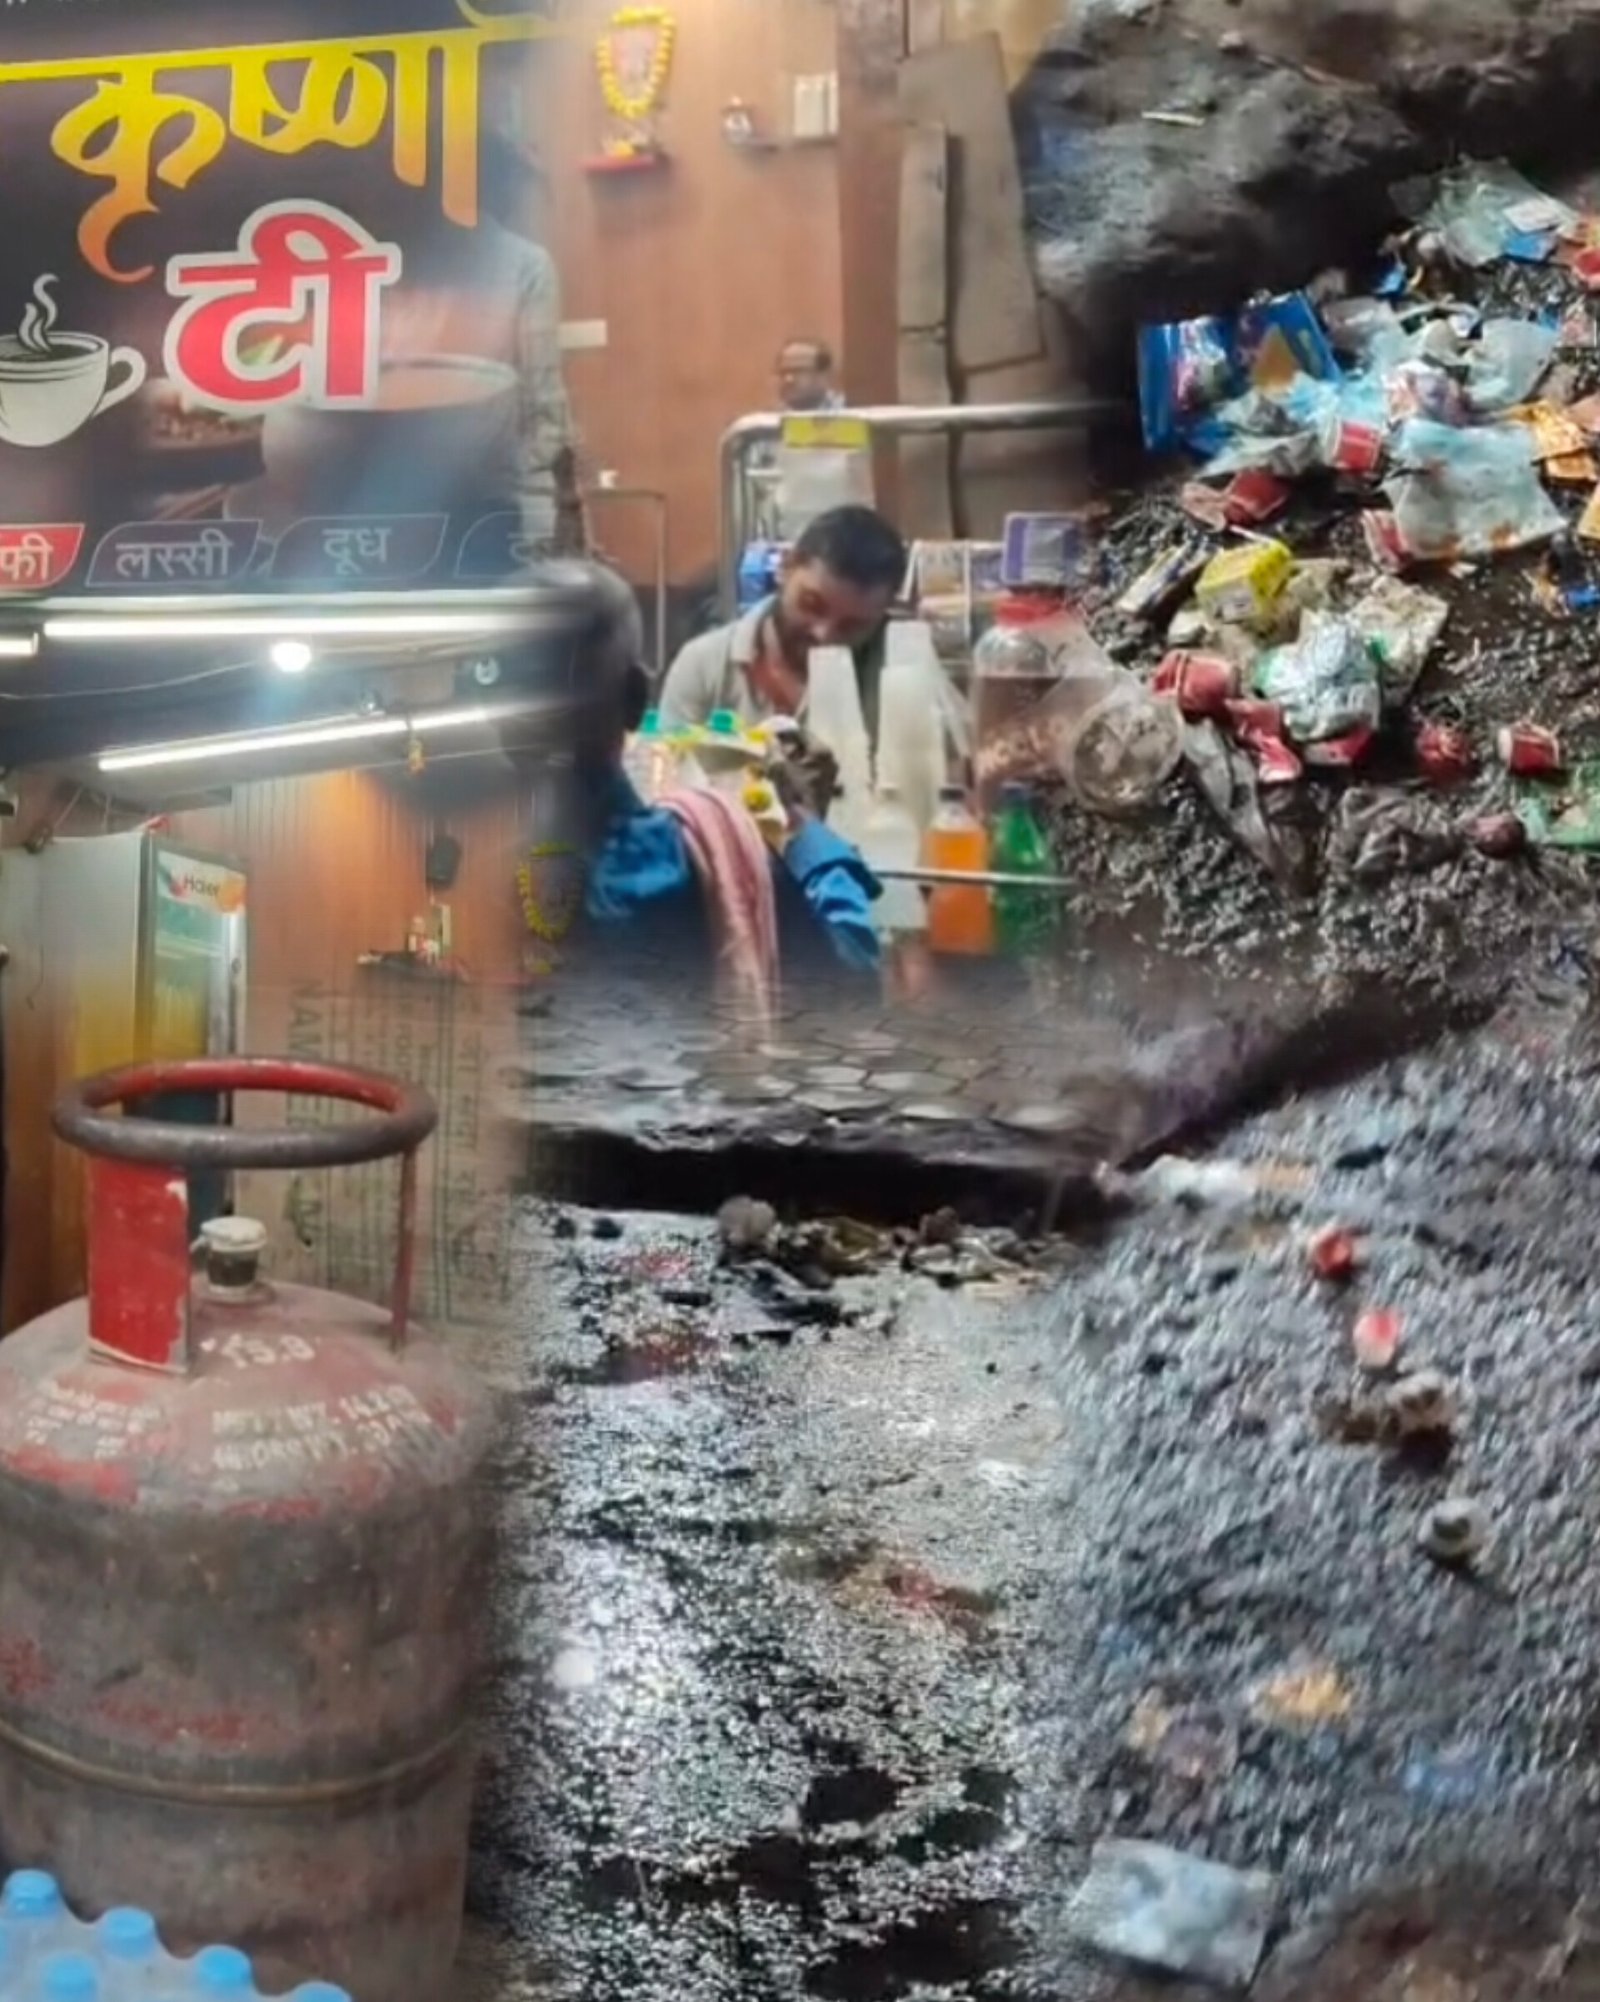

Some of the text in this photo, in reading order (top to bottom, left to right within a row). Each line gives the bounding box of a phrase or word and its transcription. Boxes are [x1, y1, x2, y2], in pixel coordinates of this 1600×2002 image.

[164, 199, 401, 413] टी
[0, 532, 53, 581] फी
[115, 527, 234, 579] लस्सी
[321, 526, 393, 576] दूध
